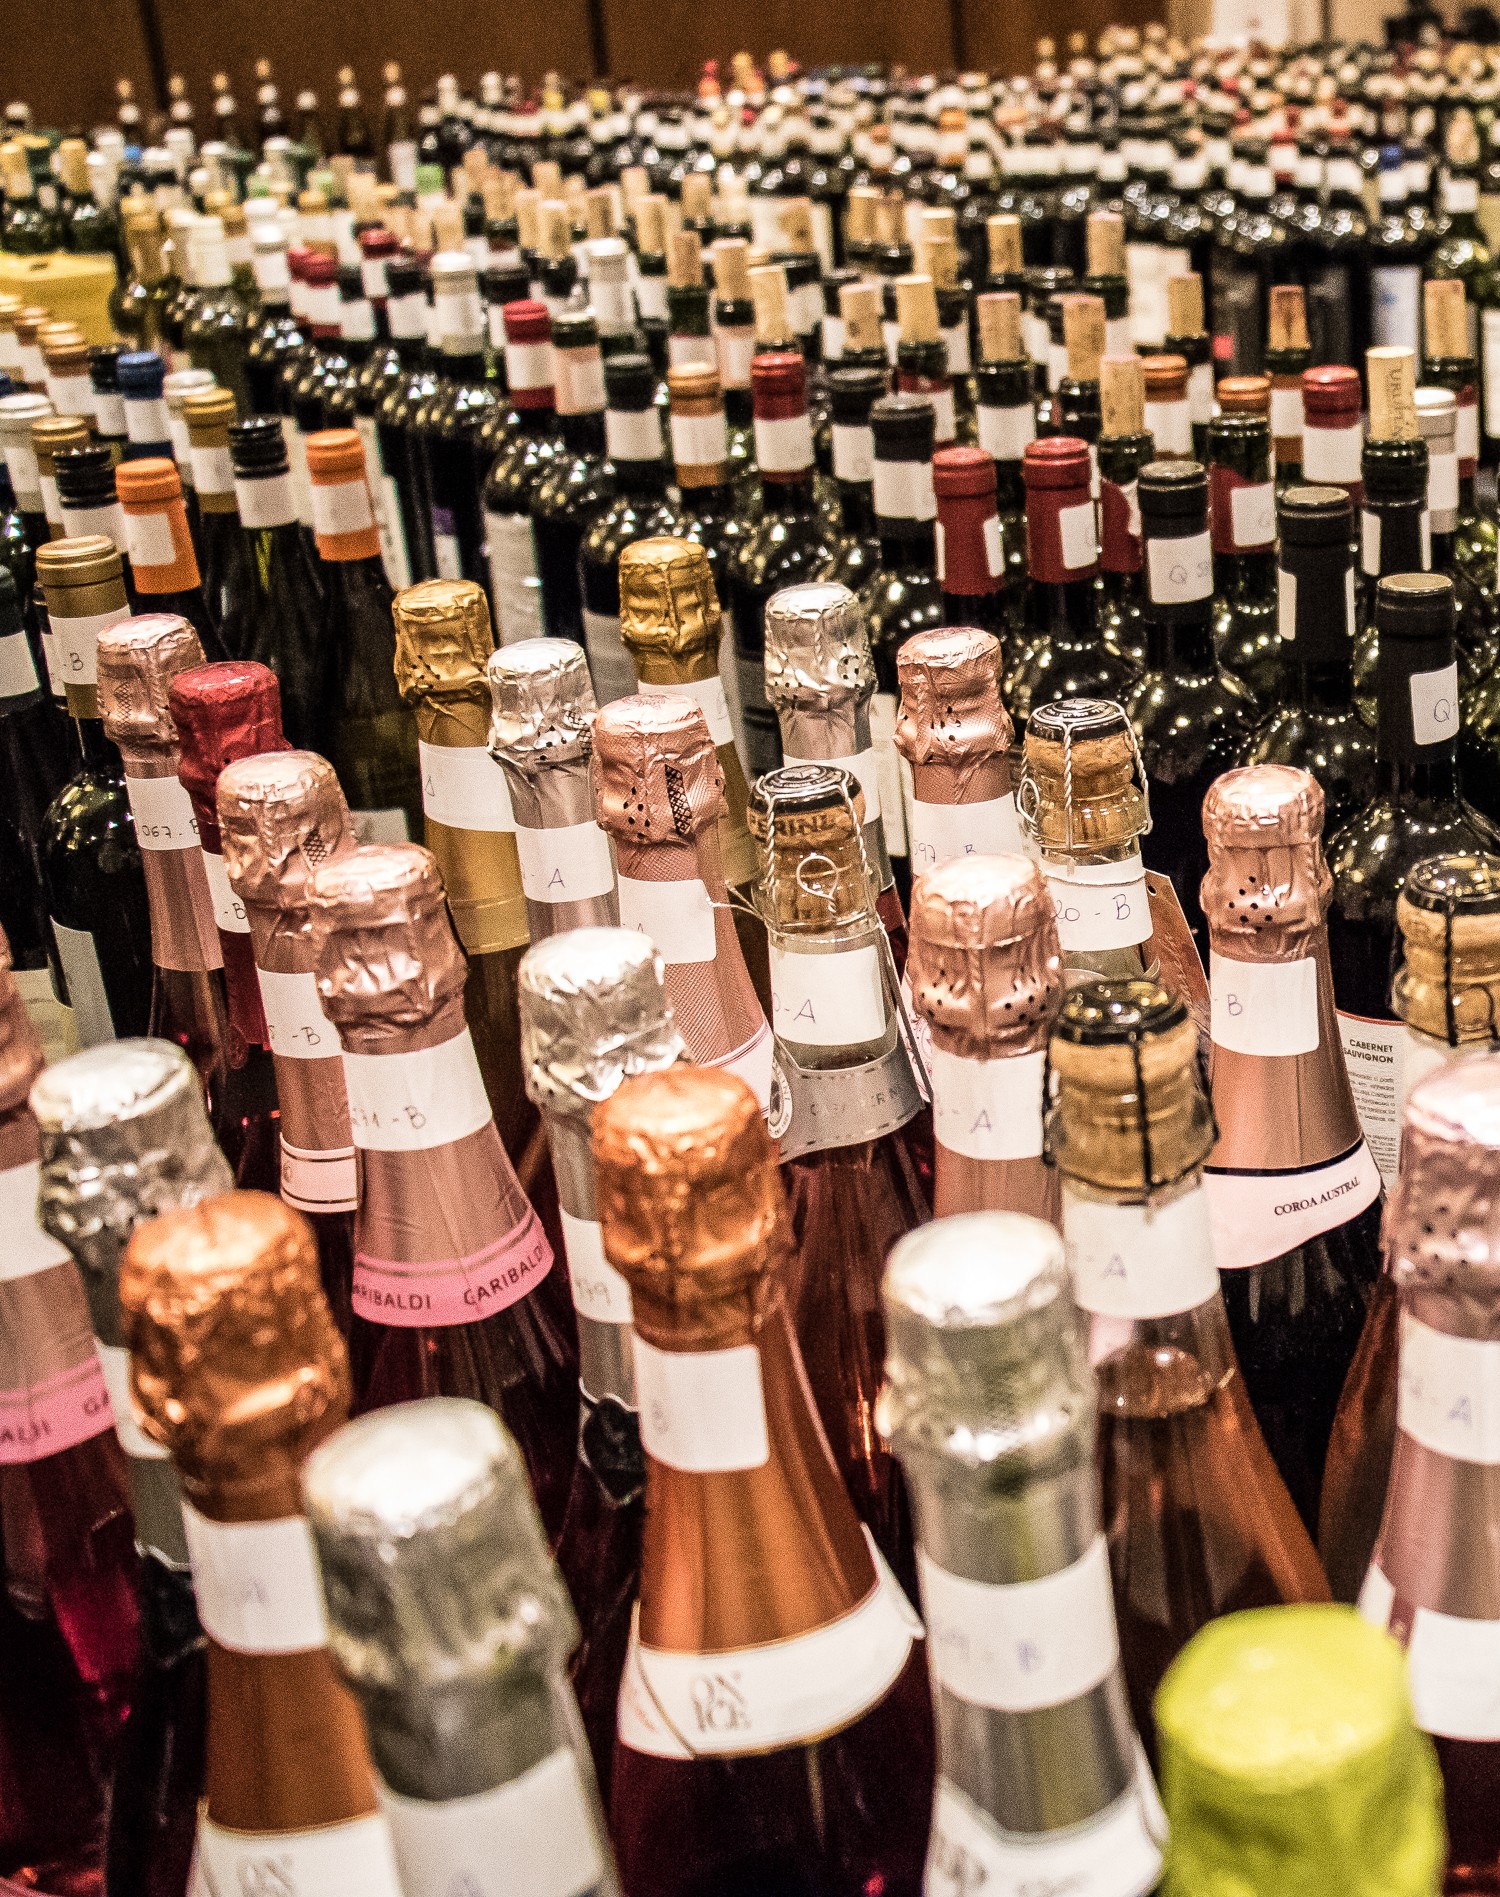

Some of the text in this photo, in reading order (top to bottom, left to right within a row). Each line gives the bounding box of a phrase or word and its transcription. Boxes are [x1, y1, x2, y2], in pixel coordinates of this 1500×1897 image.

[1350, 1039, 1394, 1053] CABERNET
[1274, 1176, 1360, 1216] COROA AUSTRAL
[352, 1283, 431, 1310] ARIBALDI
